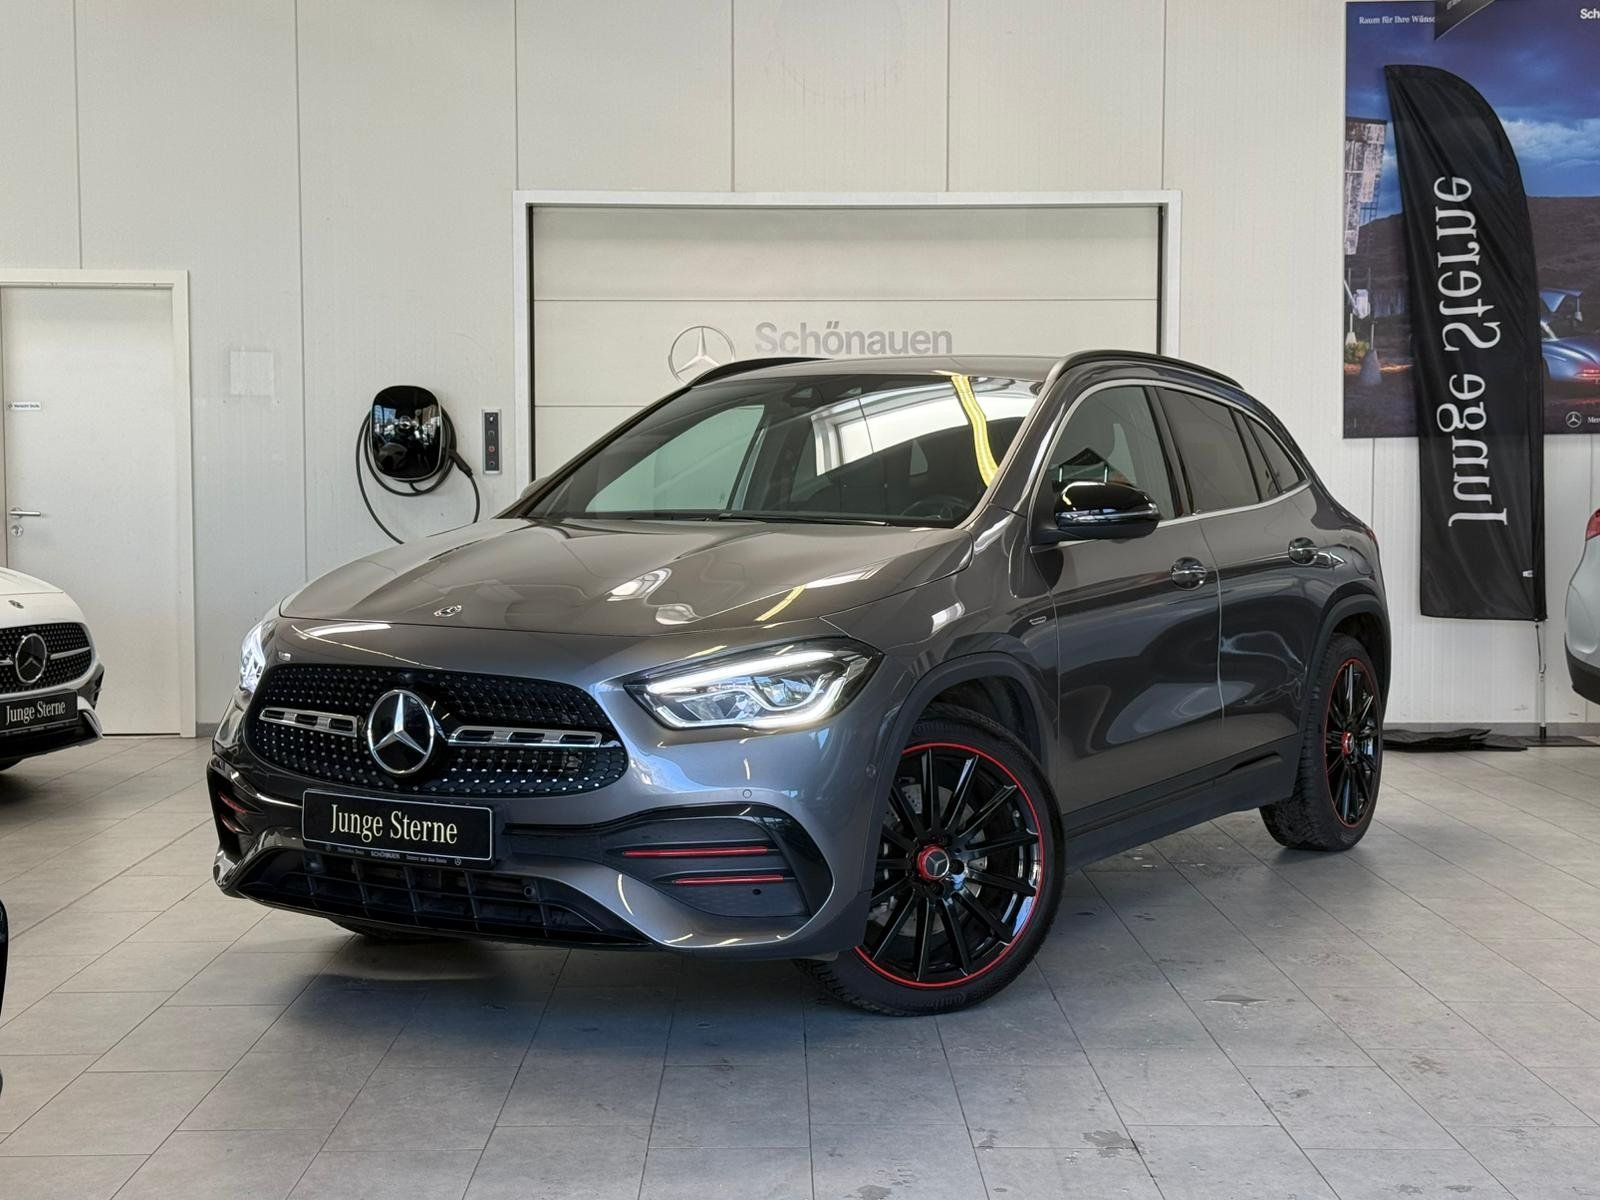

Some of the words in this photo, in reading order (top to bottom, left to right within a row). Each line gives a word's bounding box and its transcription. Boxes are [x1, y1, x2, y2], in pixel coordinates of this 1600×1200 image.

[1359, 16, 1380, 25] Raum
[1382, 15, 1393, 24] für
[1394, 15, 1410, 23] Ihre
[755, 320, 953, 355] Schönauen
[5, 705, 35, 725] Junge
[37, 701, 66, 718] Sterne
[330, 804, 383, 843] Junge
[390, 811, 458, 844] Sterne
